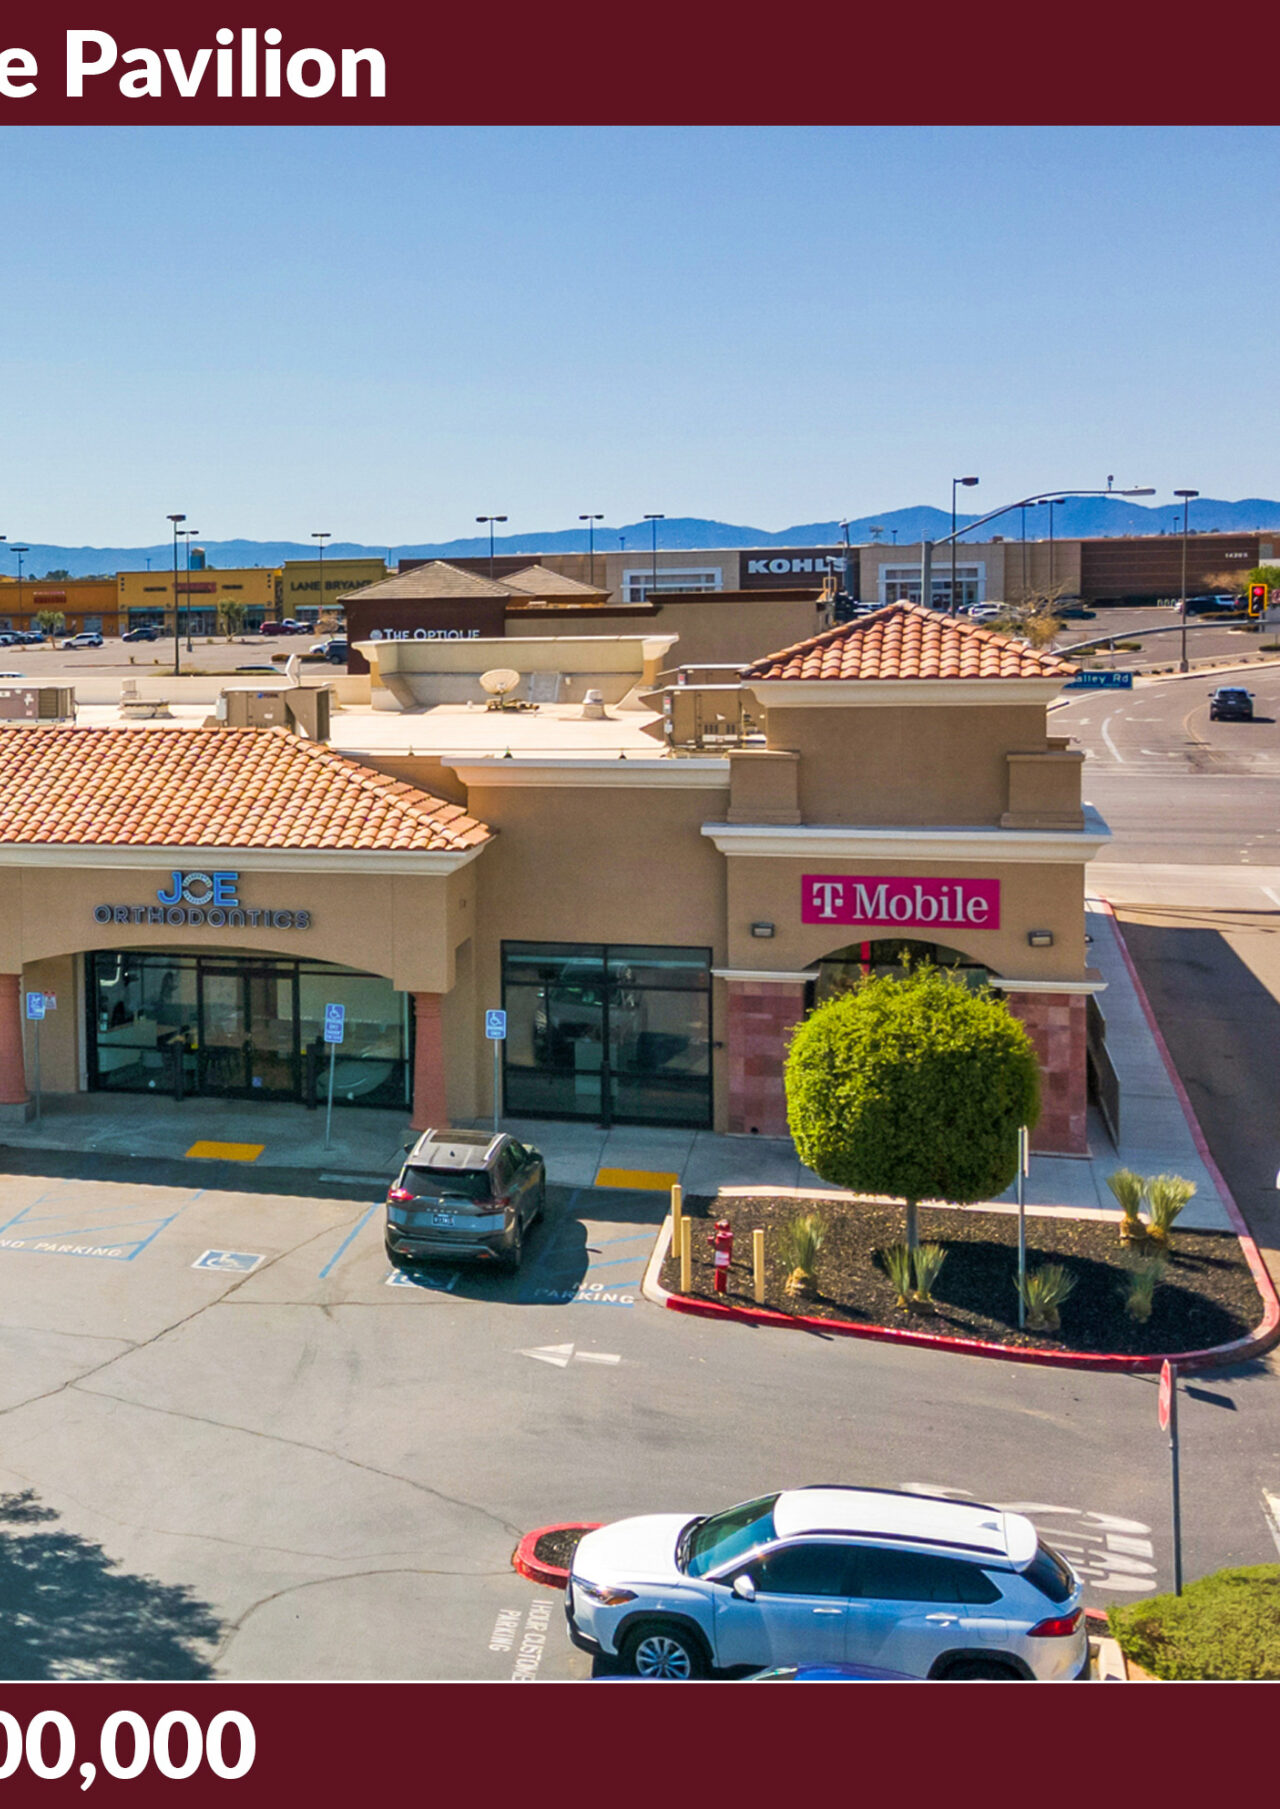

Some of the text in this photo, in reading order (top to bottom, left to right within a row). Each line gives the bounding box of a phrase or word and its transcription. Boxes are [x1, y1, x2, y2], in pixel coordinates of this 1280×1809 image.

[748, 557, 848, 574] KOHLS
[290, 580, 373, 592] LANE BRYANT
[1074, 673, 1129, 684] alley Rd
[157, 871, 239, 907] JOE
[852, 883, 989, 924] Mobile
[93, 904, 312, 930] ORTHODONTICS
[33, 1241, 123, 1257] PARKING
[572, 1282, 605, 1292] NO
[534, 1288, 635, 1304] PARKING
[524, 1604, 553, 1631] HOUR
[488, 1608, 523, 1652] PARKING
